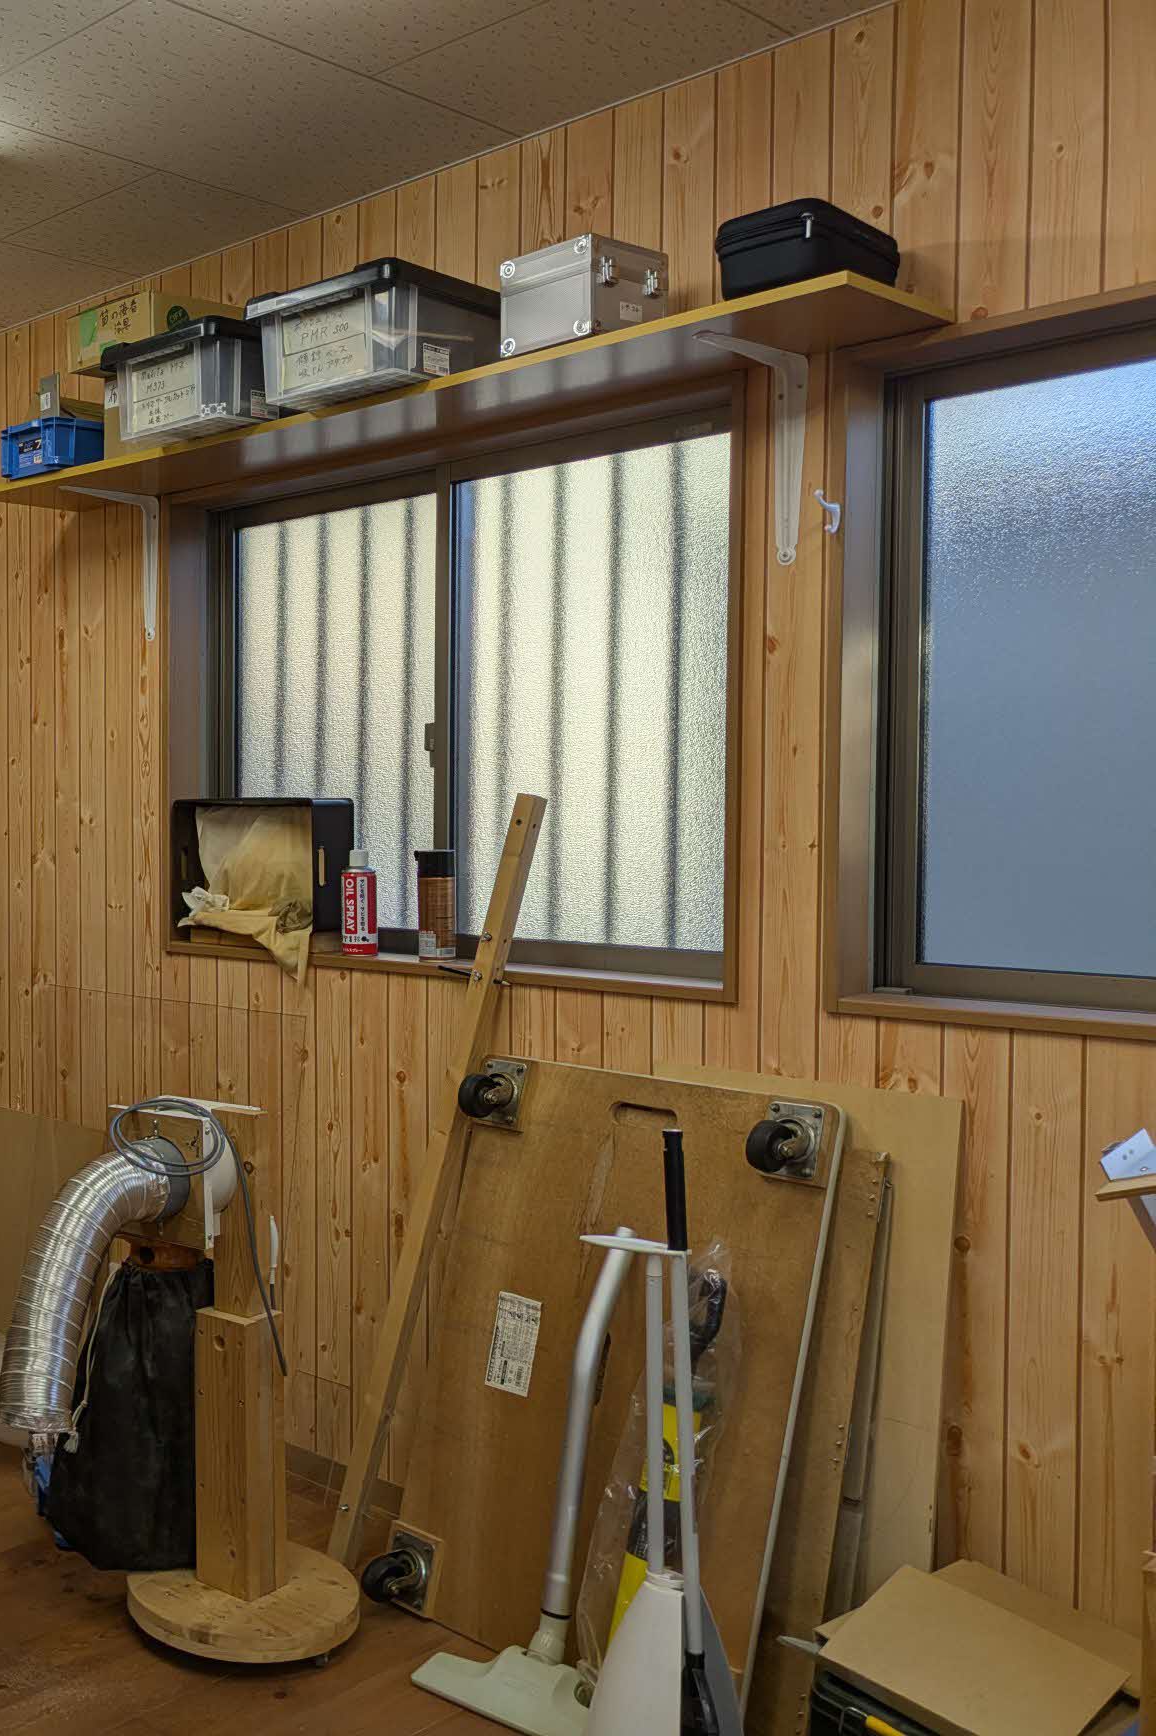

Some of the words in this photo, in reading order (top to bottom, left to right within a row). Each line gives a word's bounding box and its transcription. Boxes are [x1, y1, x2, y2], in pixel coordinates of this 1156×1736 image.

[301, 326, 328, 345] PMR
[345, 878, 355, 897] OIL
[346, 899, 355, 931] SPRAY
